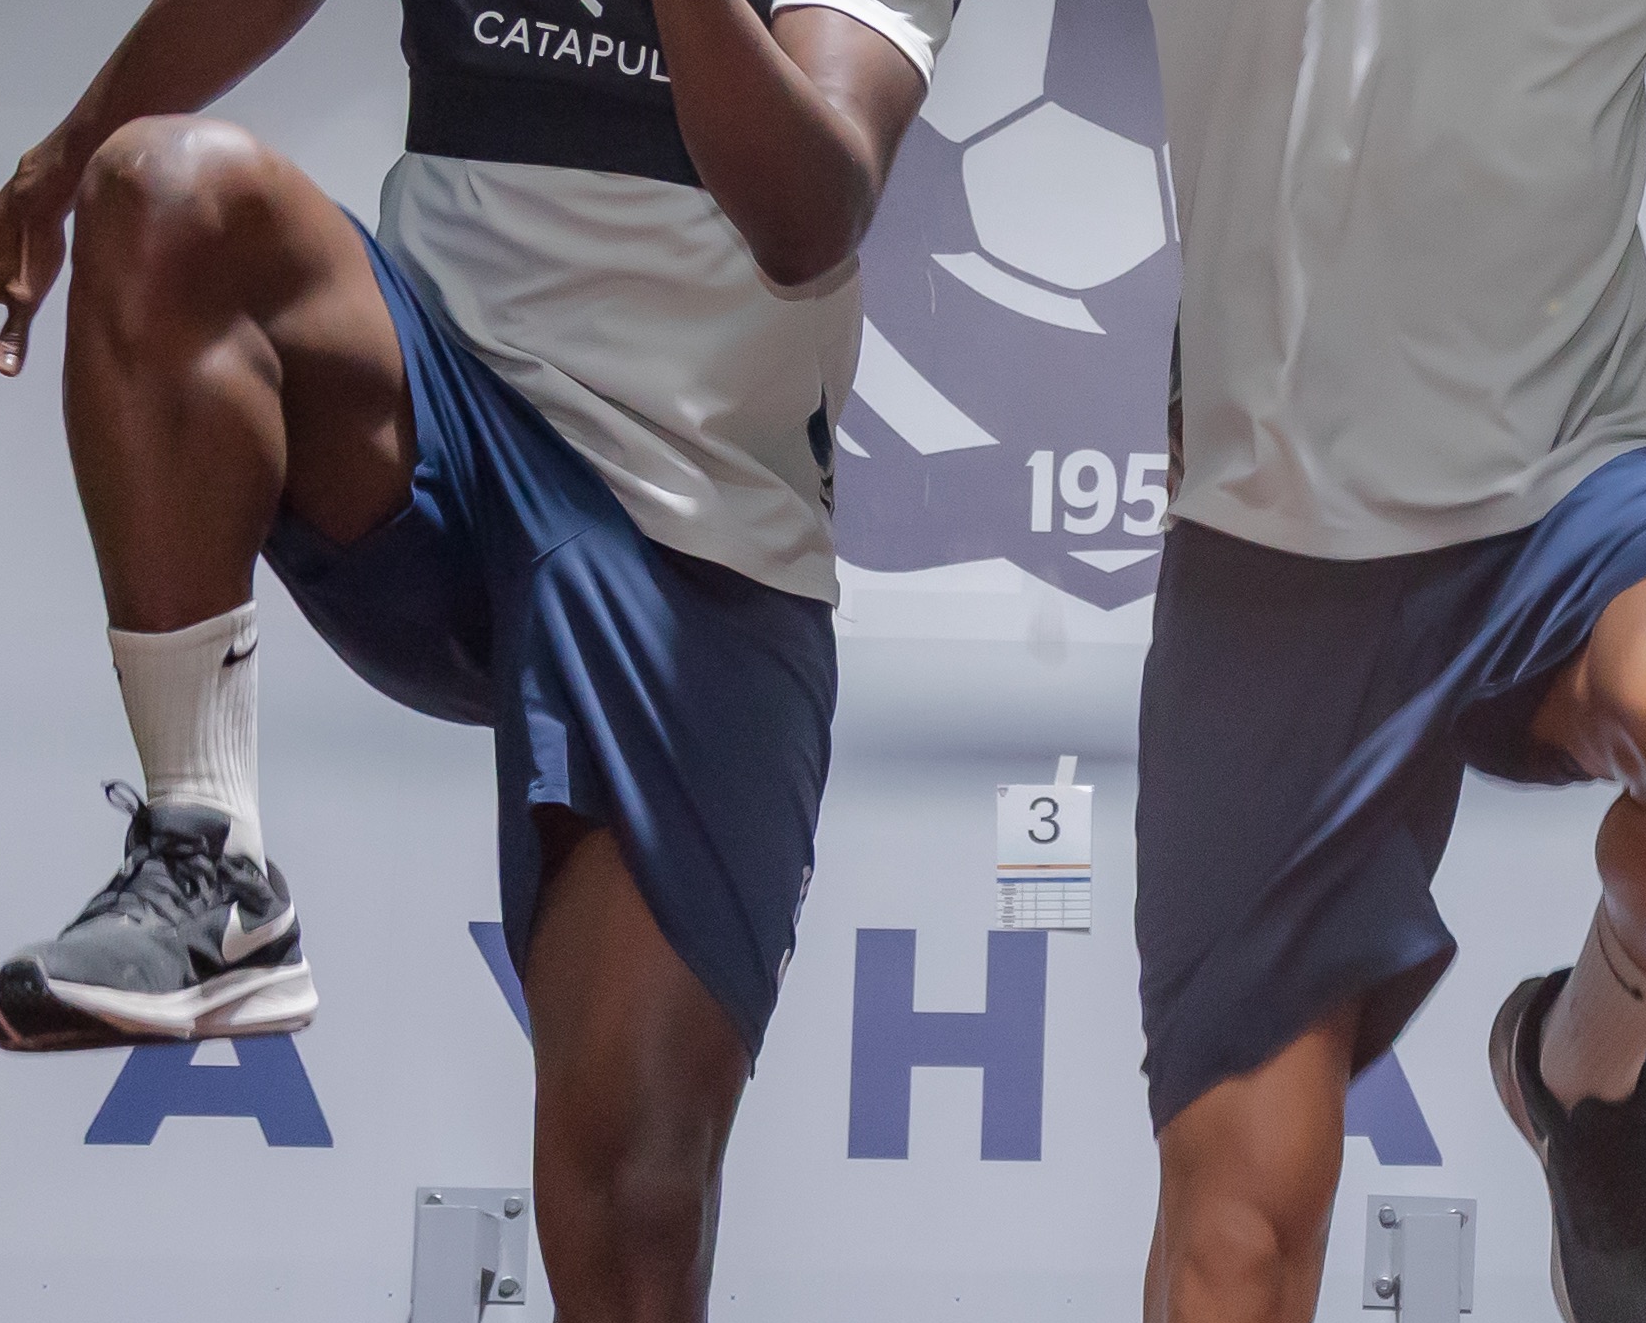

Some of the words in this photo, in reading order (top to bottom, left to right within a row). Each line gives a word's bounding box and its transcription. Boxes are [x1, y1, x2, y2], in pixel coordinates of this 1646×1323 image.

[473, 10, 672, 83] CATAPUL
[1025, 449, 1170, 536] 195
[1028, 796, 1061, 845] 3
